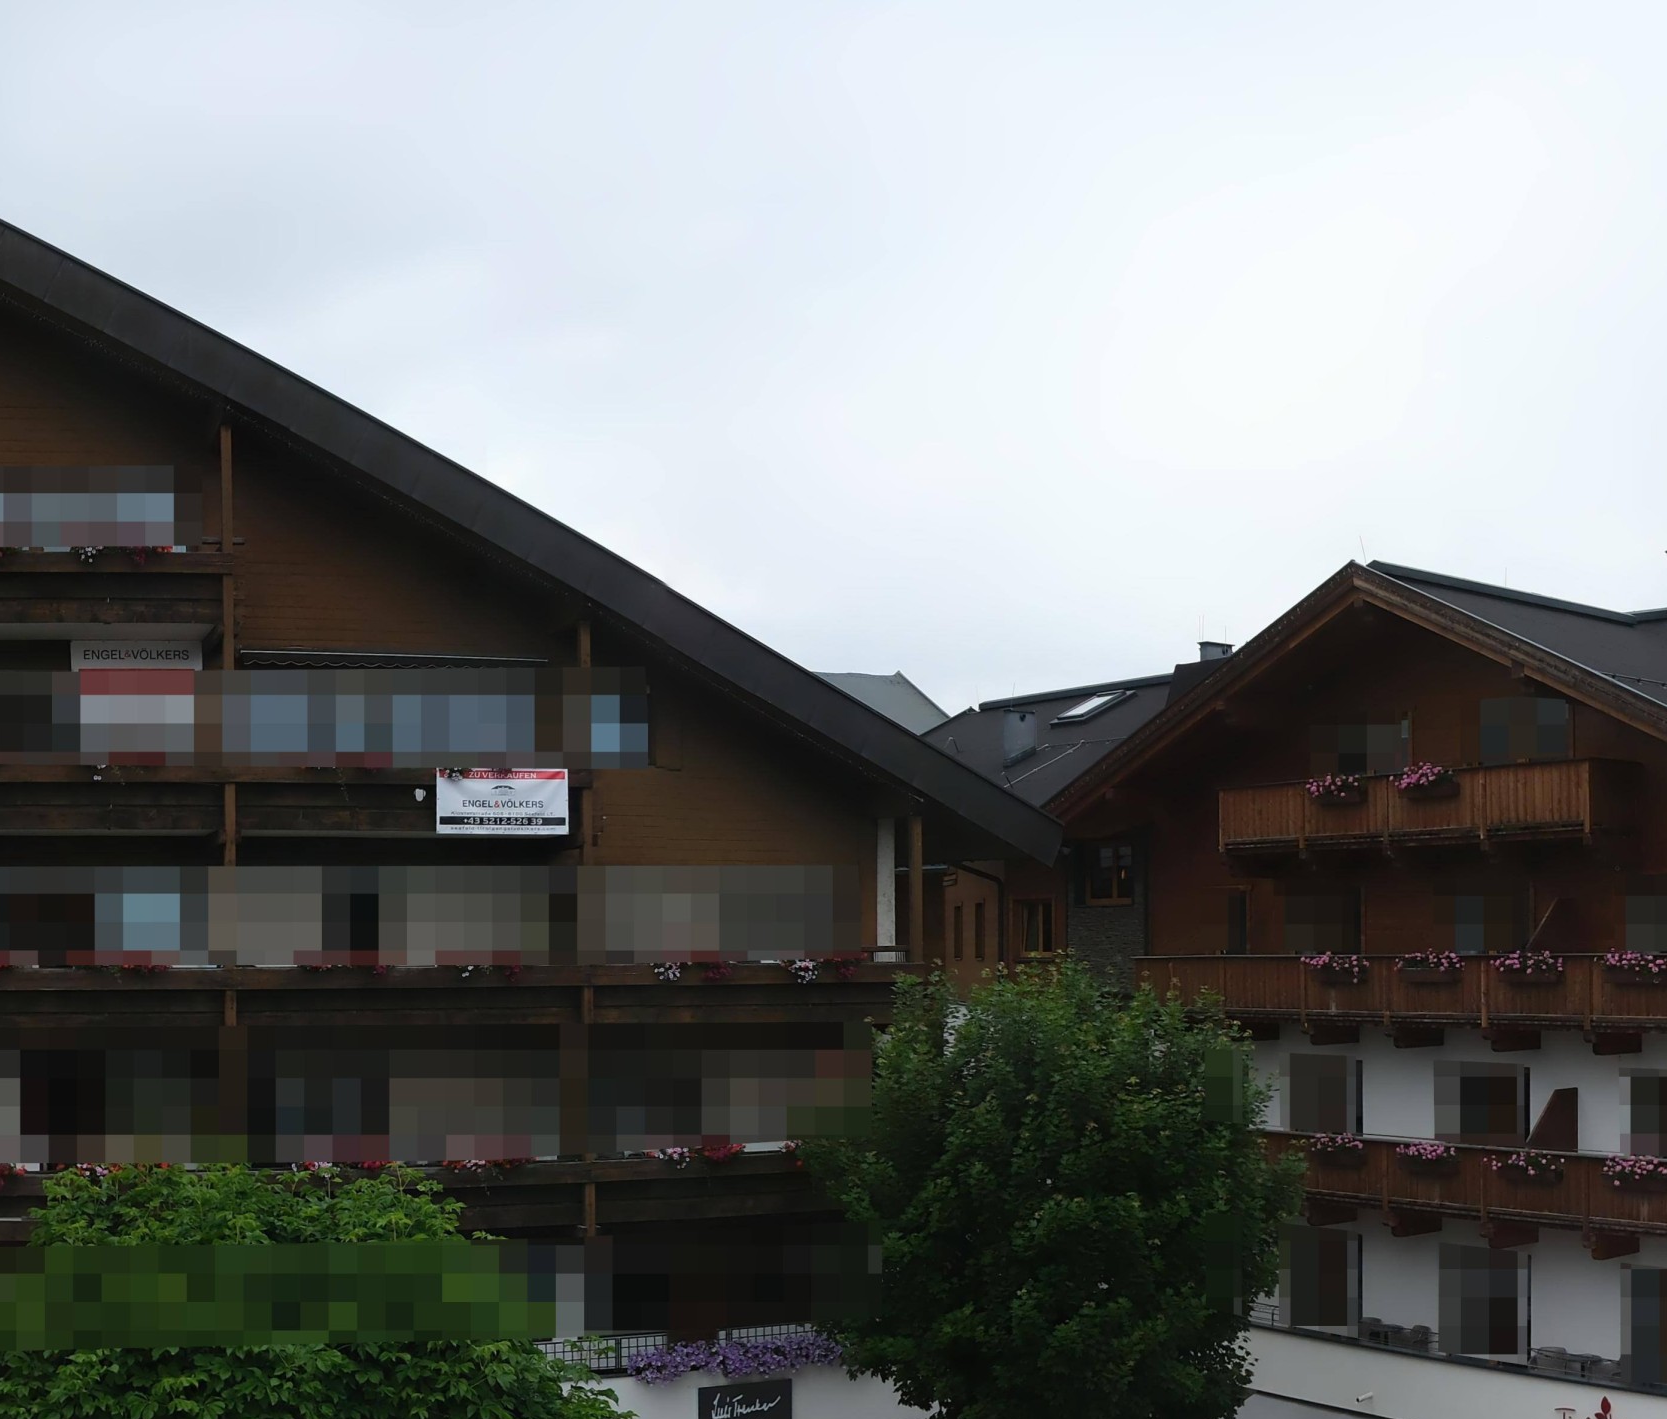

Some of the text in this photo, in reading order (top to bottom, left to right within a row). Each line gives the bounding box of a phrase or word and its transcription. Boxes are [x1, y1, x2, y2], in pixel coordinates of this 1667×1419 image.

[83, 647, 190, 661] ENGEL&VÖLKERS
[468, 771, 482, 779] ZU
[462, 798, 544, 809] ENGEL&VÖLKERS
